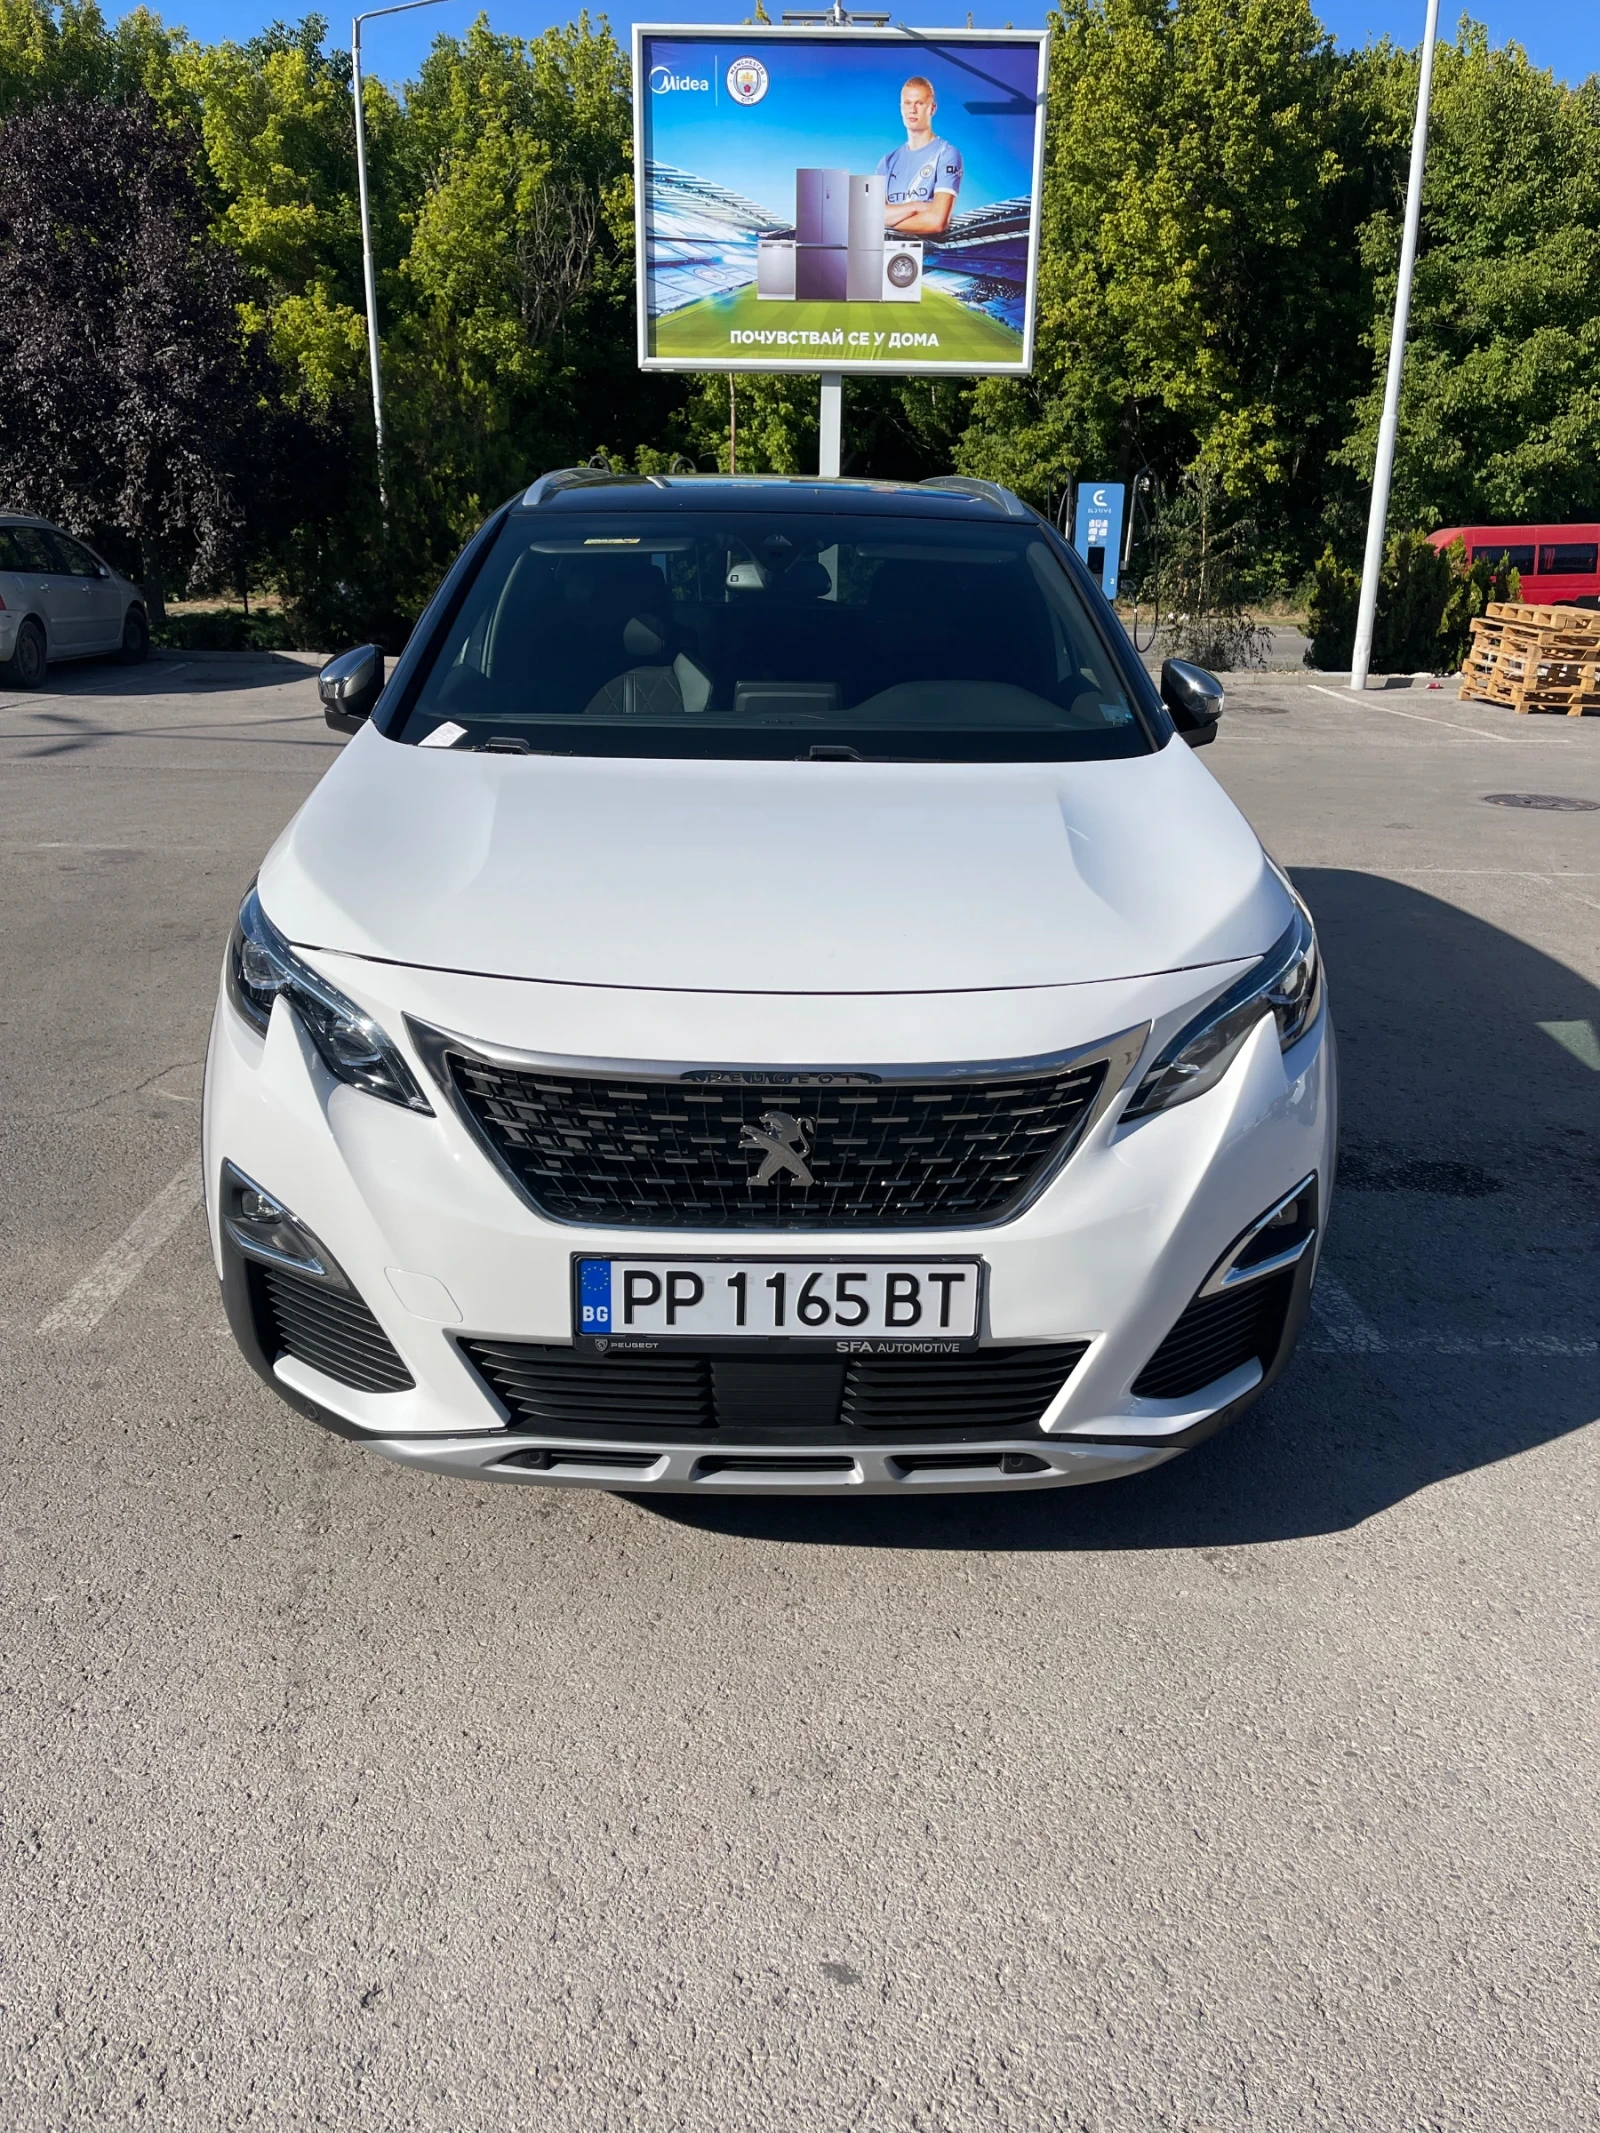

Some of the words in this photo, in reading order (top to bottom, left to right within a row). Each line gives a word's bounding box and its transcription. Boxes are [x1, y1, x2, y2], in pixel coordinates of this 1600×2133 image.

[730, 60, 765, 75] MANCHESTER
[656, 74, 709, 91] Midea
[888, 187, 928, 203] ETIHAD
[730, 328, 844, 345] ПОЧУВСТВАЙ
[848, 332, 870, 346] СЕ
[873, 332, 886, 346] У
[888, 332, 940, 349] ДОМА
[706, 1072, 857, 1085] PEUGEOT
[582, 1306, 609, 1323] BG
[836, 1341, 874, 1353] SFA
[876, 1342, 960, 1353] AUTOMOTIVE
